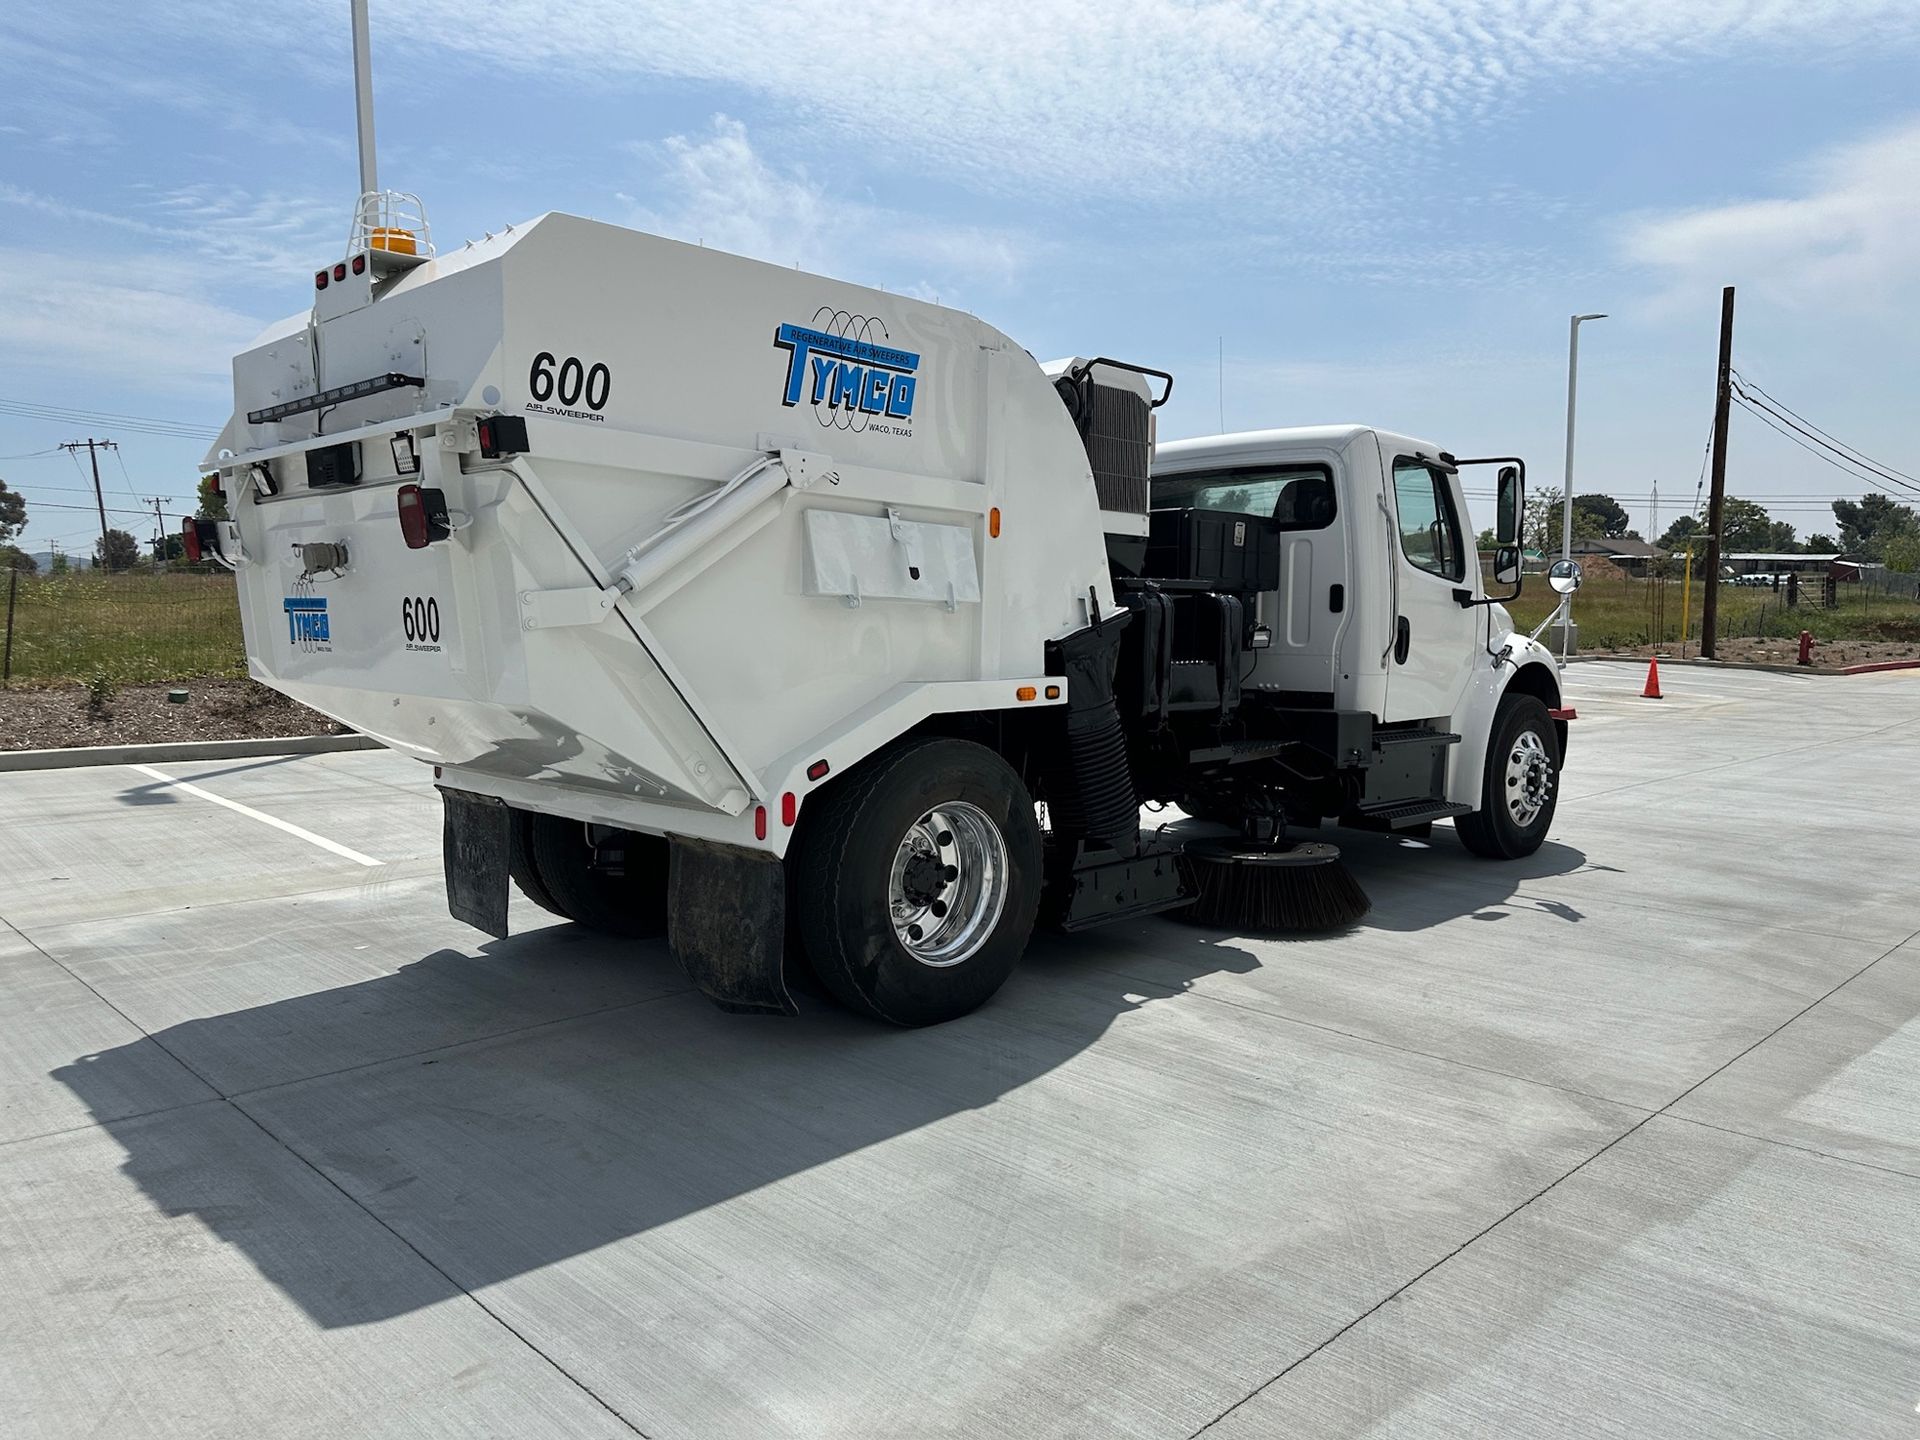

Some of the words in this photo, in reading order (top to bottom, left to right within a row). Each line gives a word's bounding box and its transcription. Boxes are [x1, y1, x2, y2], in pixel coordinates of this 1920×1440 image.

[790, 329, 851, 352] REGENERATIVE
[853, 345, 868, 356] AIR
[868, 347, 910, 365] SWEEPERS
[529, 351, 611, 411] 600
[526, 402, 543, 410] AIR
[546, 406, 604, 421] SWEEPER
[868, 423, 891, 435] WACO,
[892, 427, 912, 438] TEXAS
[402, 596, 440, 643] 600
[414, 644, 441, 652] SWEEPER
